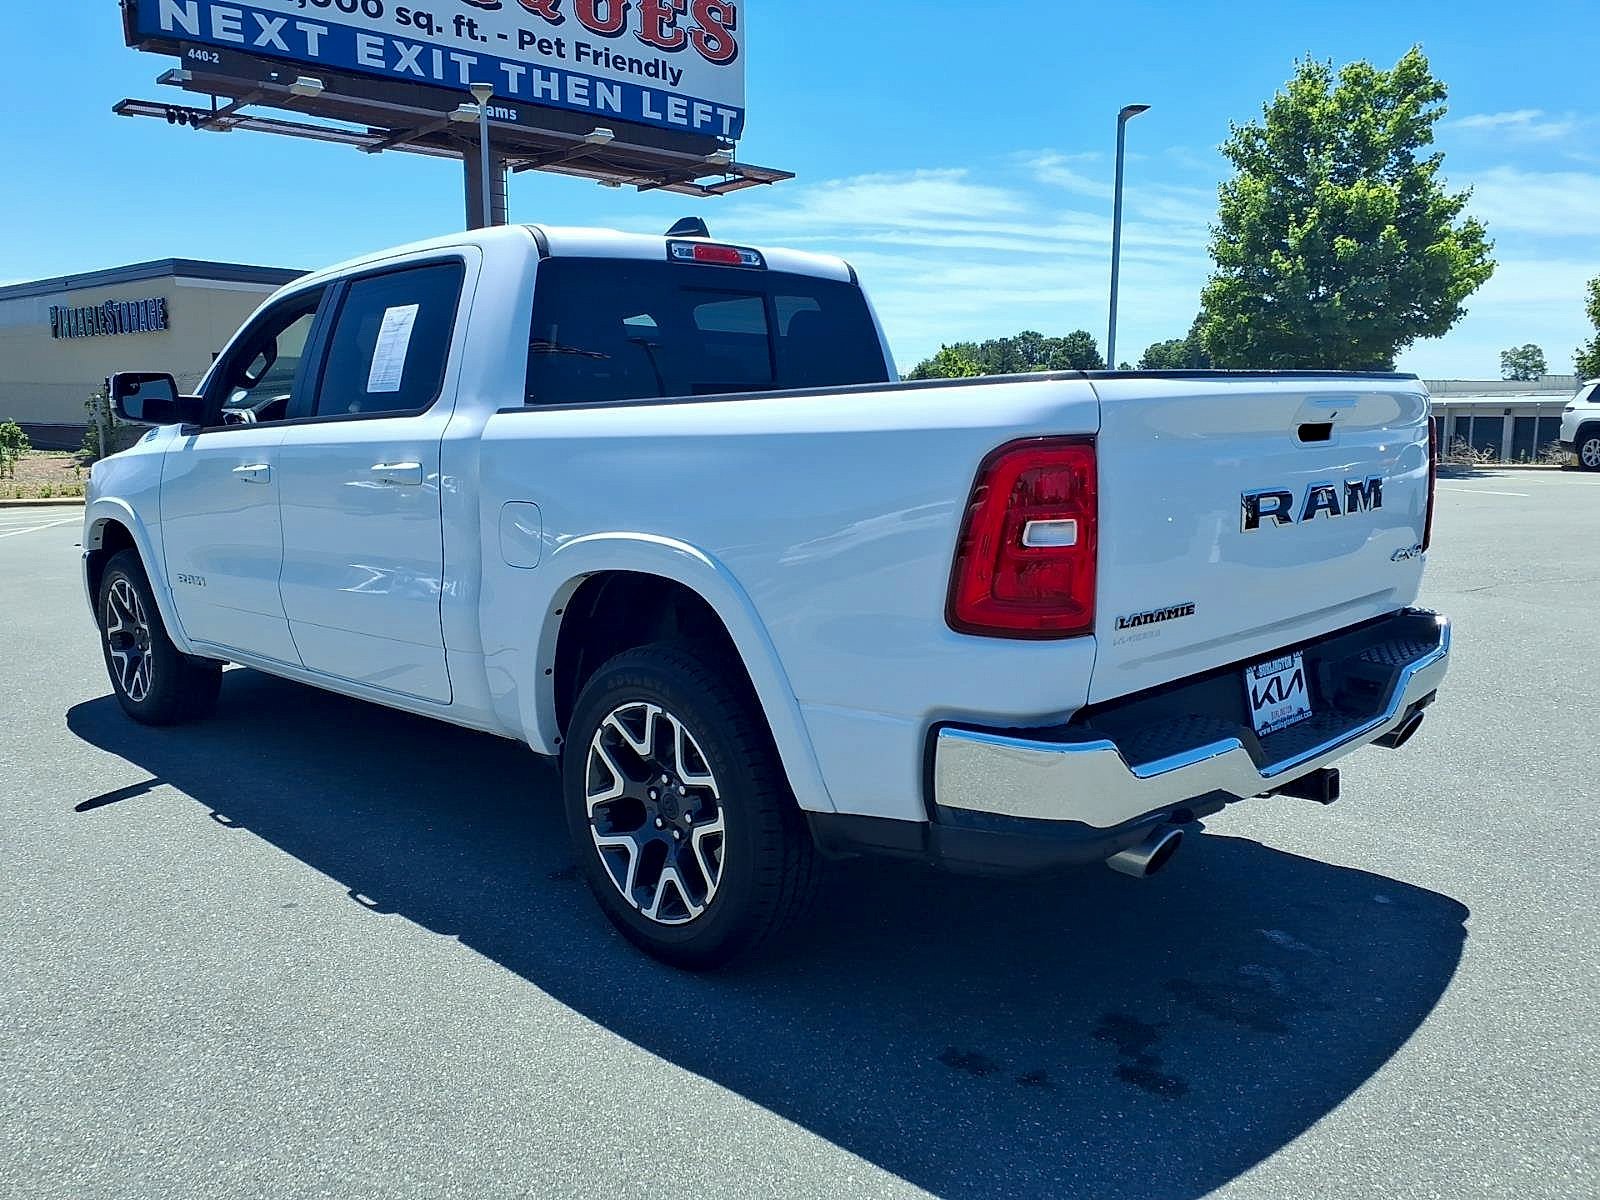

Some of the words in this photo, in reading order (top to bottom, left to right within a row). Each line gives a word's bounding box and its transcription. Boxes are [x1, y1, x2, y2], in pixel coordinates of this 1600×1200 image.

[159, 0, 328, 57] NEXT
[356, 32, 478, 85] EXIT
[499, 62, 622, 112] THEN
[642, 91, 737, 135] LEFT
[187, 48, 220, 63] 440-2
[395, 6, 443, 36] sq.
[452, 15, 488, 43] ft.
[517, 28, 566, 57] Pet
[575, 41, 683, 87] Friendly
[1240, 474, 1384, 533] RAM
